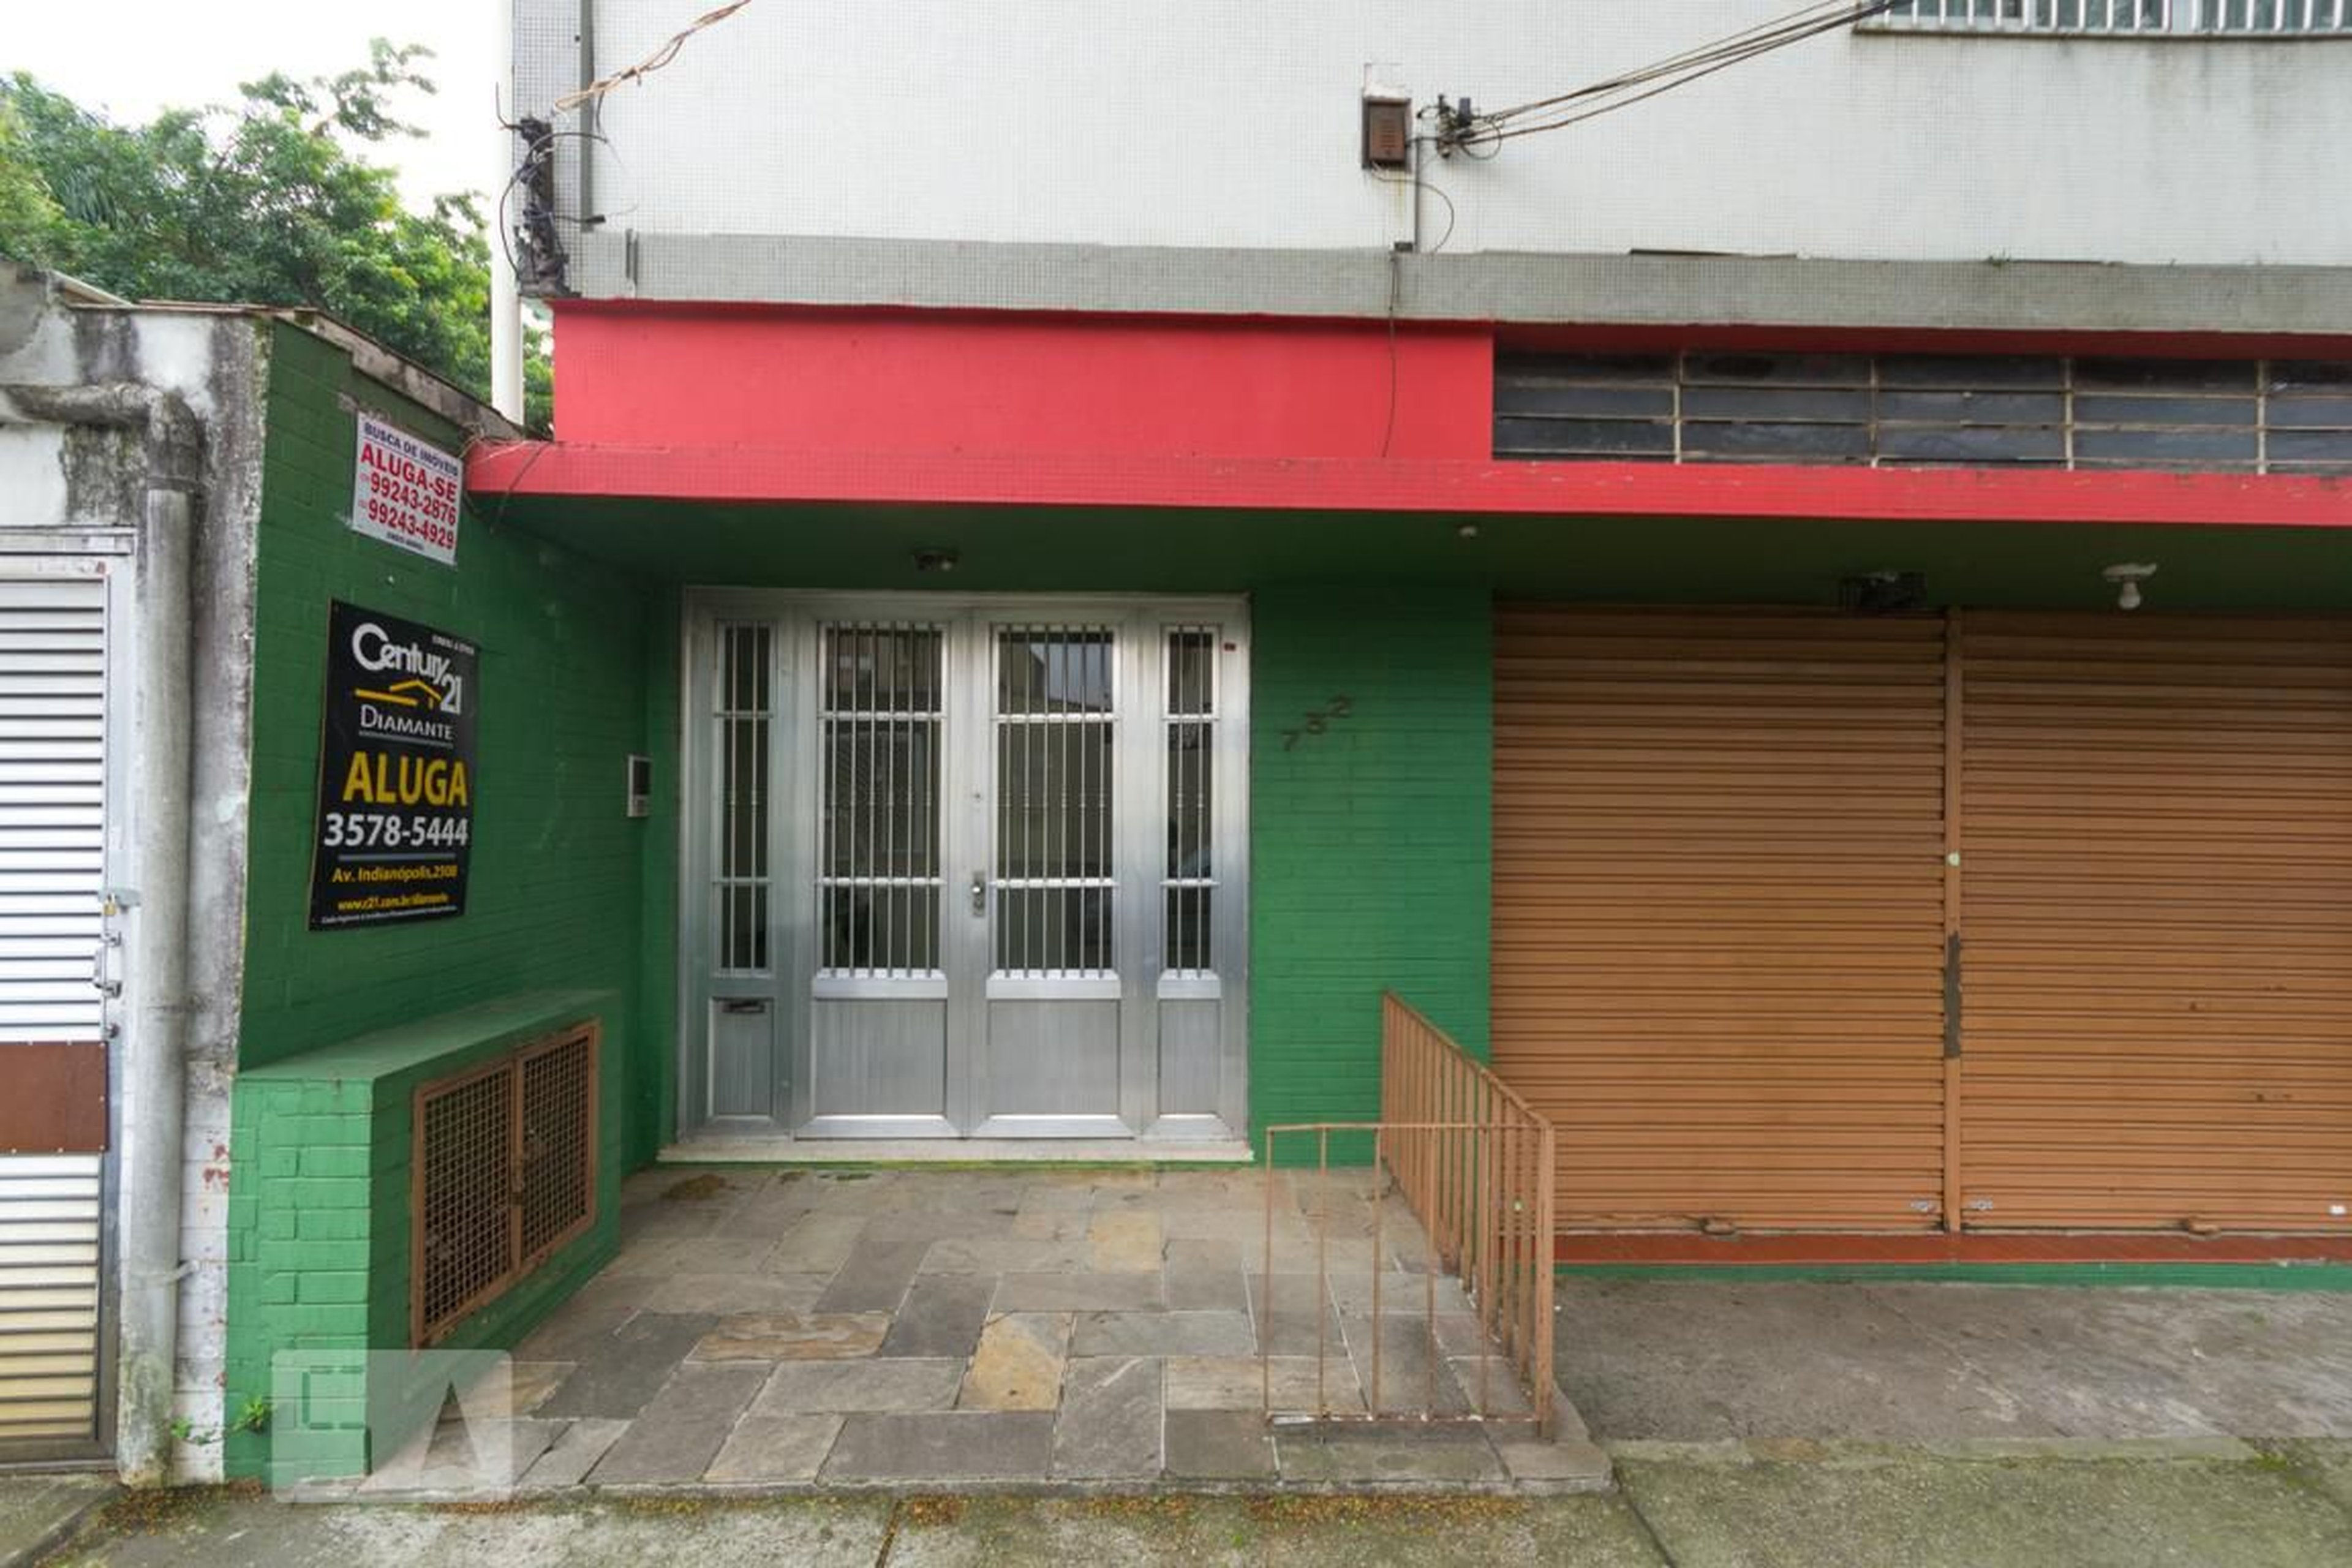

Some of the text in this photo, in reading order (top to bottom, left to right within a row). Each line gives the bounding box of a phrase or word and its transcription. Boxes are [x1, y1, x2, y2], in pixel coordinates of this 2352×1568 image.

[364, 422, 401, 448] BUSCA
[404, 442, 418, 458] DE
[360, 443, 457, 502] ALUGA-SE
[369, 499, 454, 550] 99243-4929
[371, 472, 457, 527] 99243-2876
[352, 622, 450, 685] Century
[440, 673, 462, 715] 21
[360, 704, 454, 741] DIAMANTE
[1280, 695, 1353, 753] 732
[342, 750, 467, 807] ALUGA
[323, 812, 469, 847] 3578-5444
[331, 868, 356, 883] Av.
